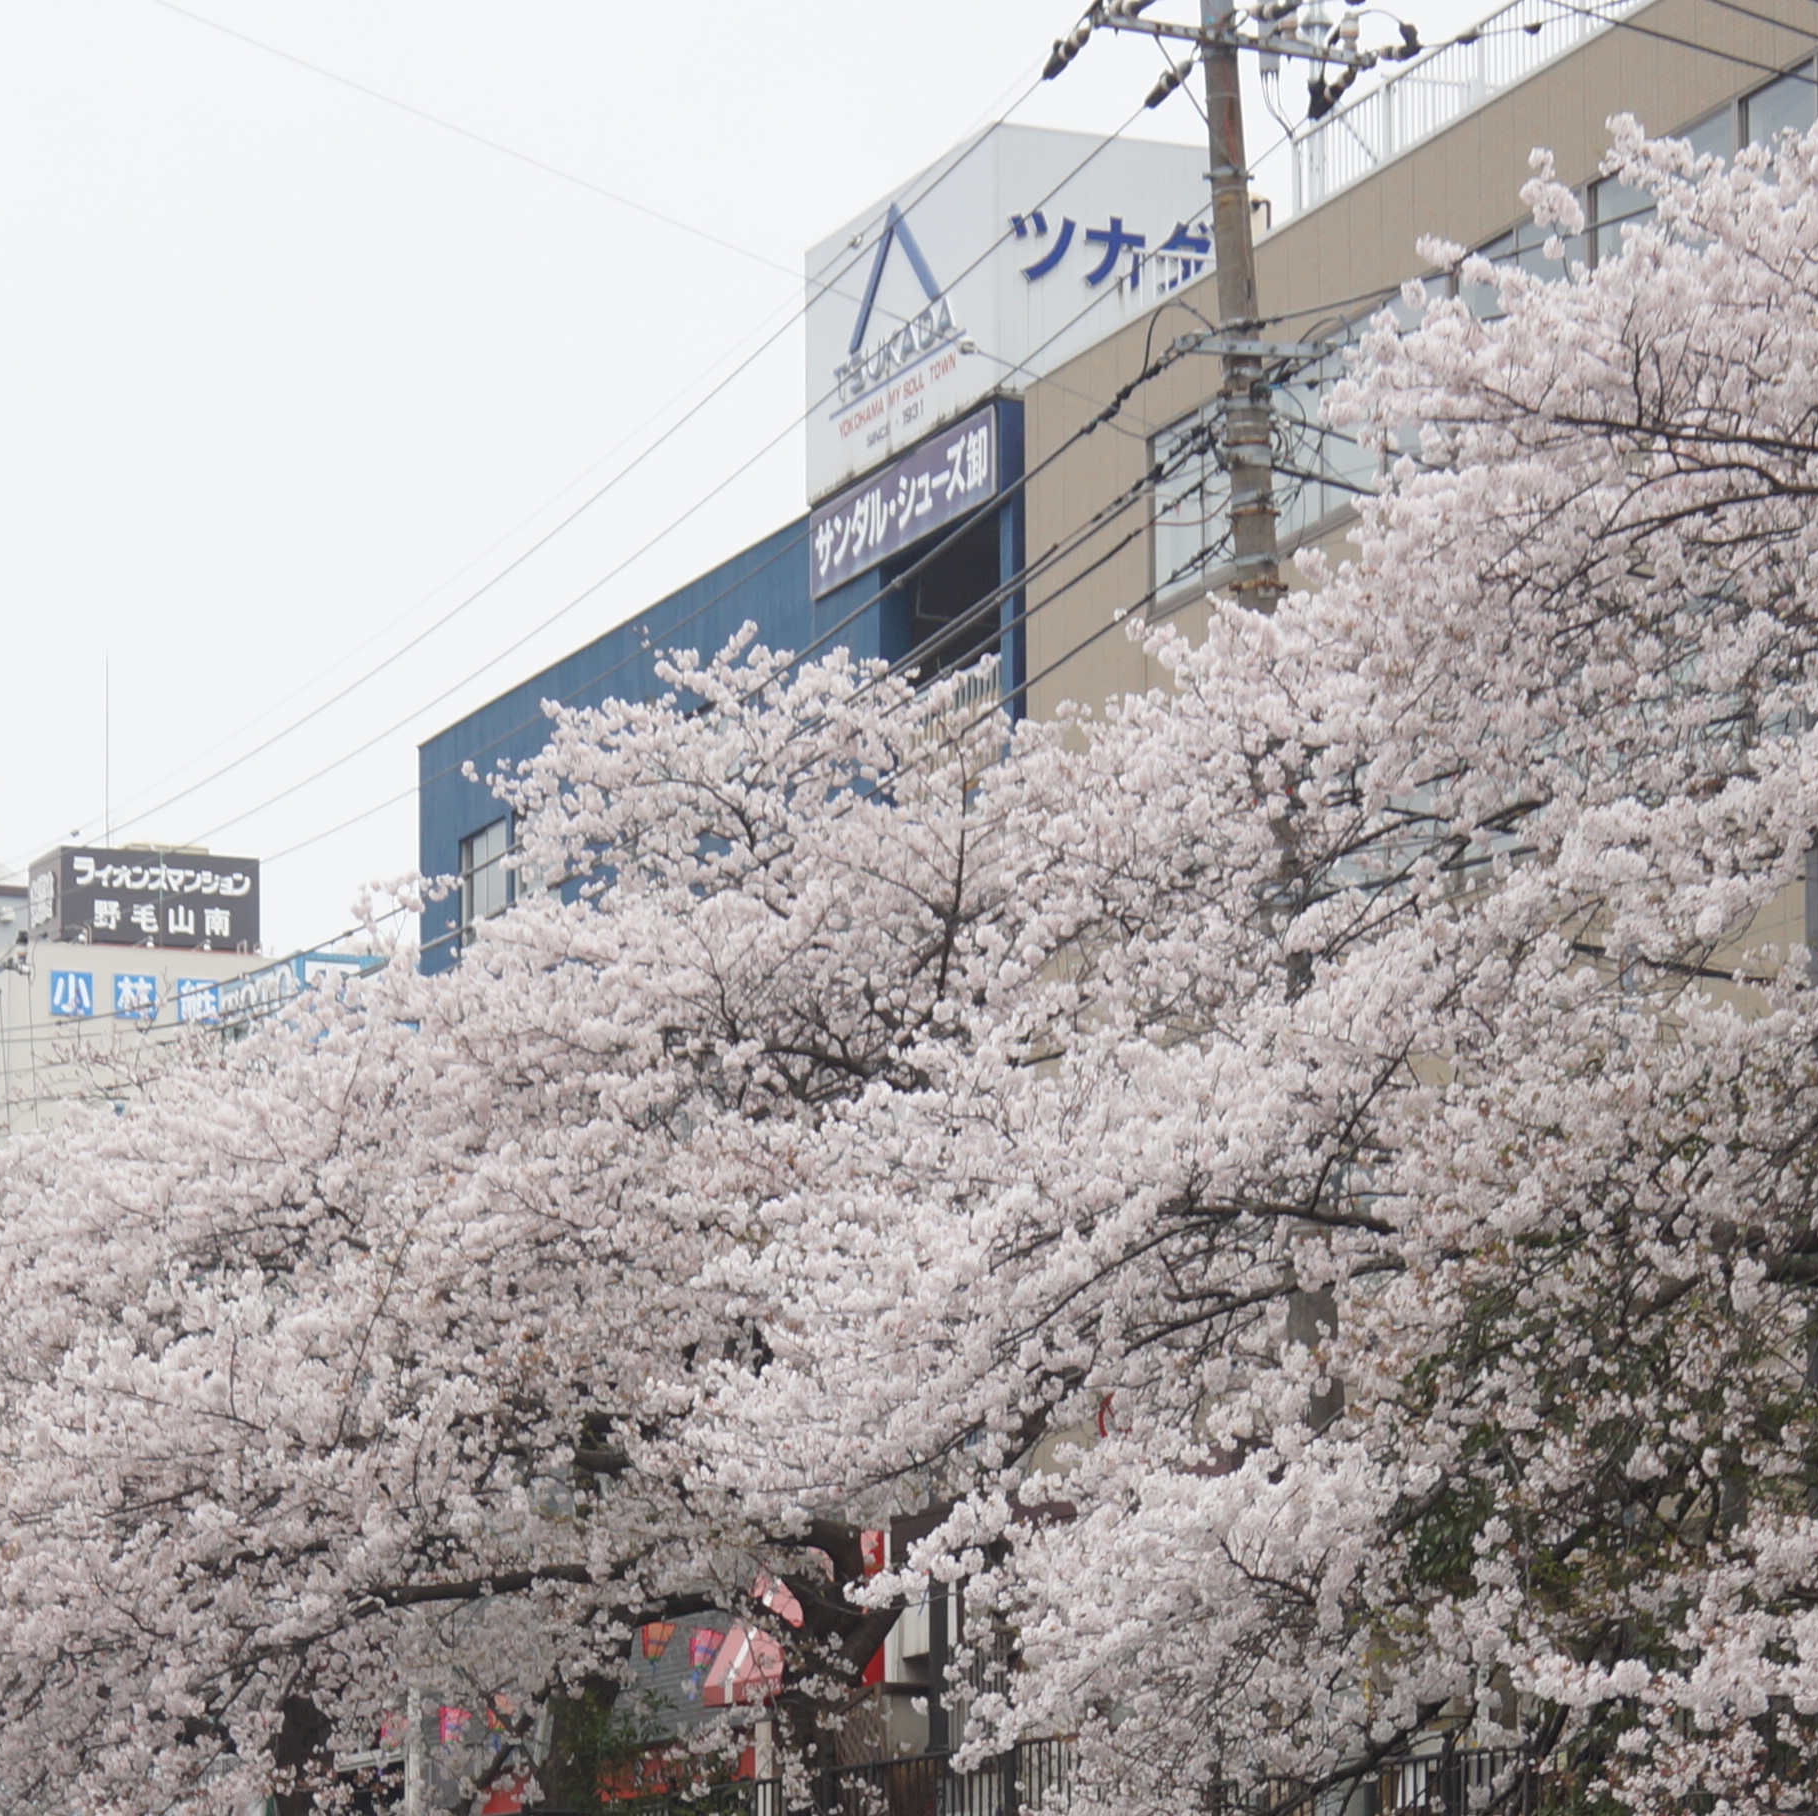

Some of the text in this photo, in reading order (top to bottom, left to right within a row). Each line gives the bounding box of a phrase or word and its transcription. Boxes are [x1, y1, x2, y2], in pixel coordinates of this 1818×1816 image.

[833, 295, 958, 404] TSUKADA
[838, 351, 957, 439] YOKOHAMA MY SOUL TOWN
[902, 398, 925, 426] 1931
[814, 424, 989, 578] サンダル・シューズ卸
[73, 854, 252, 897] ライオンズマンション
[93, 898, 232, 938] 野毛山南
